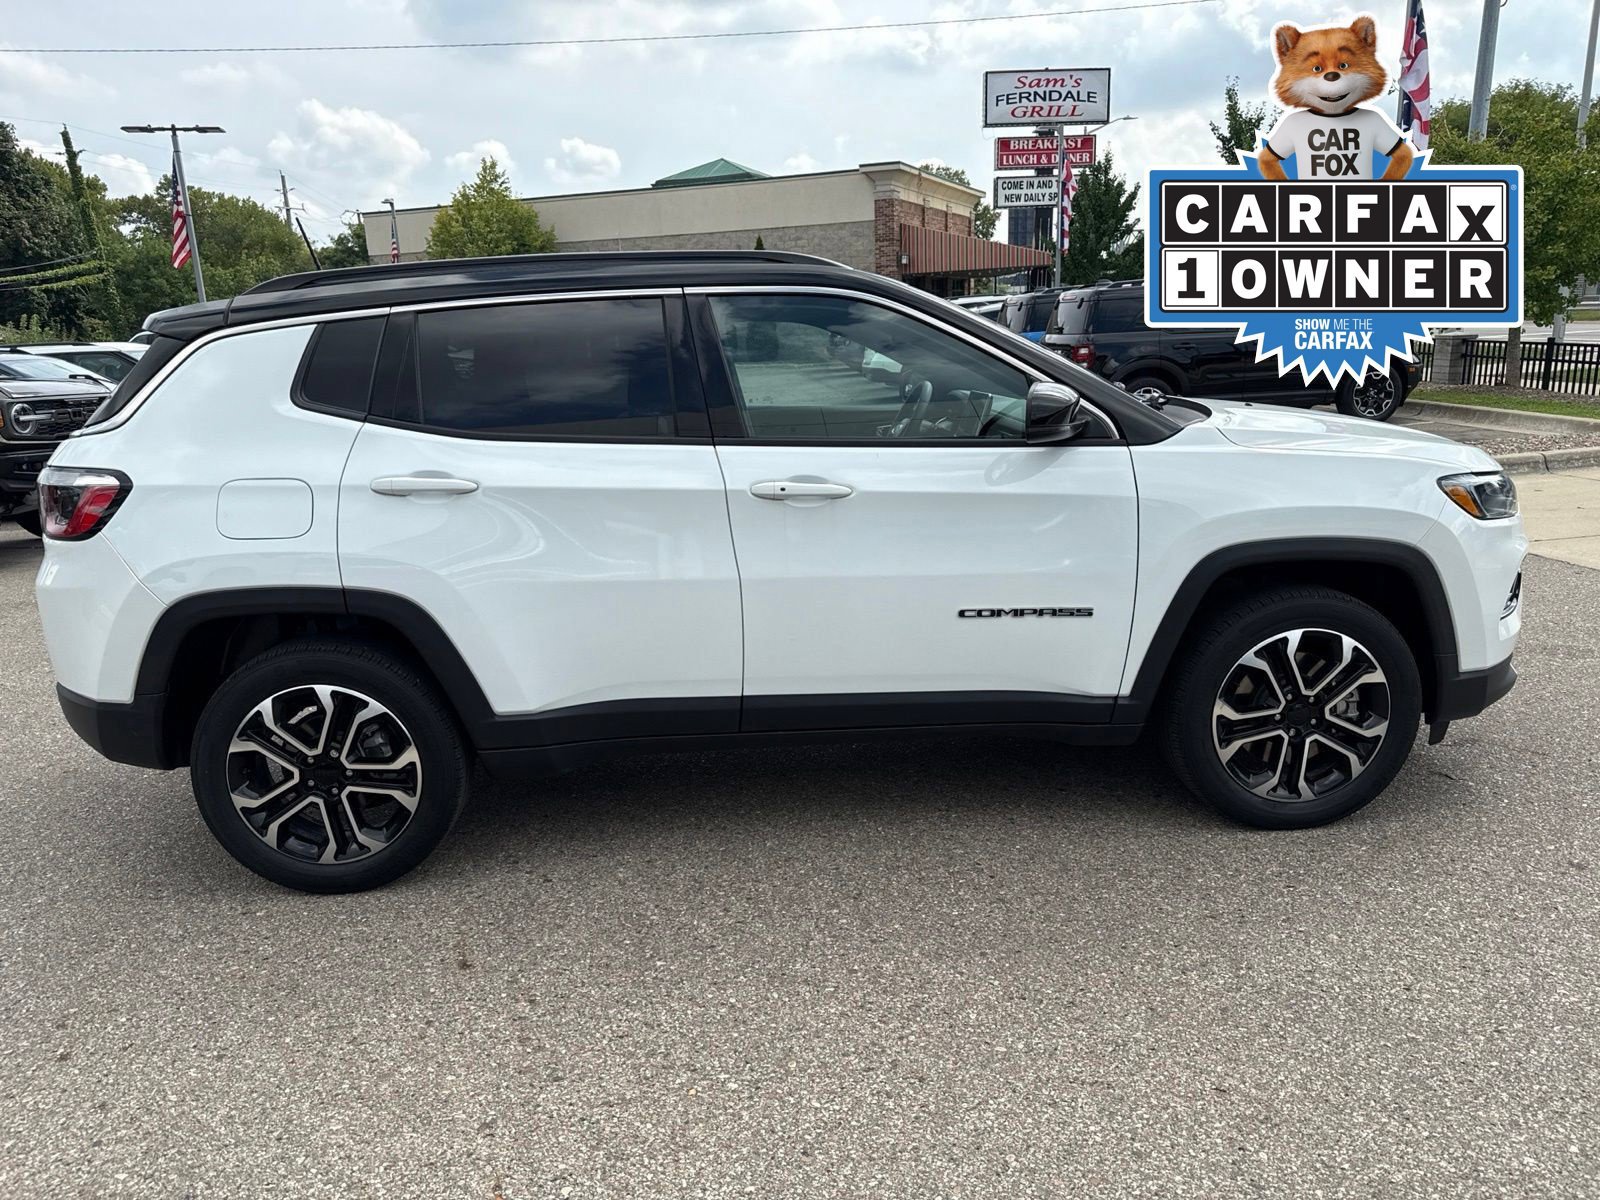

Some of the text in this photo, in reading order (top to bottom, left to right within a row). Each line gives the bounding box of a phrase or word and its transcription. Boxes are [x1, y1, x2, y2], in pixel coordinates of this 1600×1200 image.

[1014, 74, 1083, 89] Sam's
[995, 90, 1098, 107] FERNDALE
[1010, 104, 1084, 119] GRILL
[1003, 154, 1037, 165] LUNCH
[1040, 153, 1049, 164] &
[1001, 180, 1024, 191] COME
[1026, 180, 1035, 190] IN
[1036, 180, 1053, 190] AND
[1004, 193, 1022, 203] NEW
[1024, 192, 1046, 203] DAILY
[958, 607, 1094, 618] COMPASS
